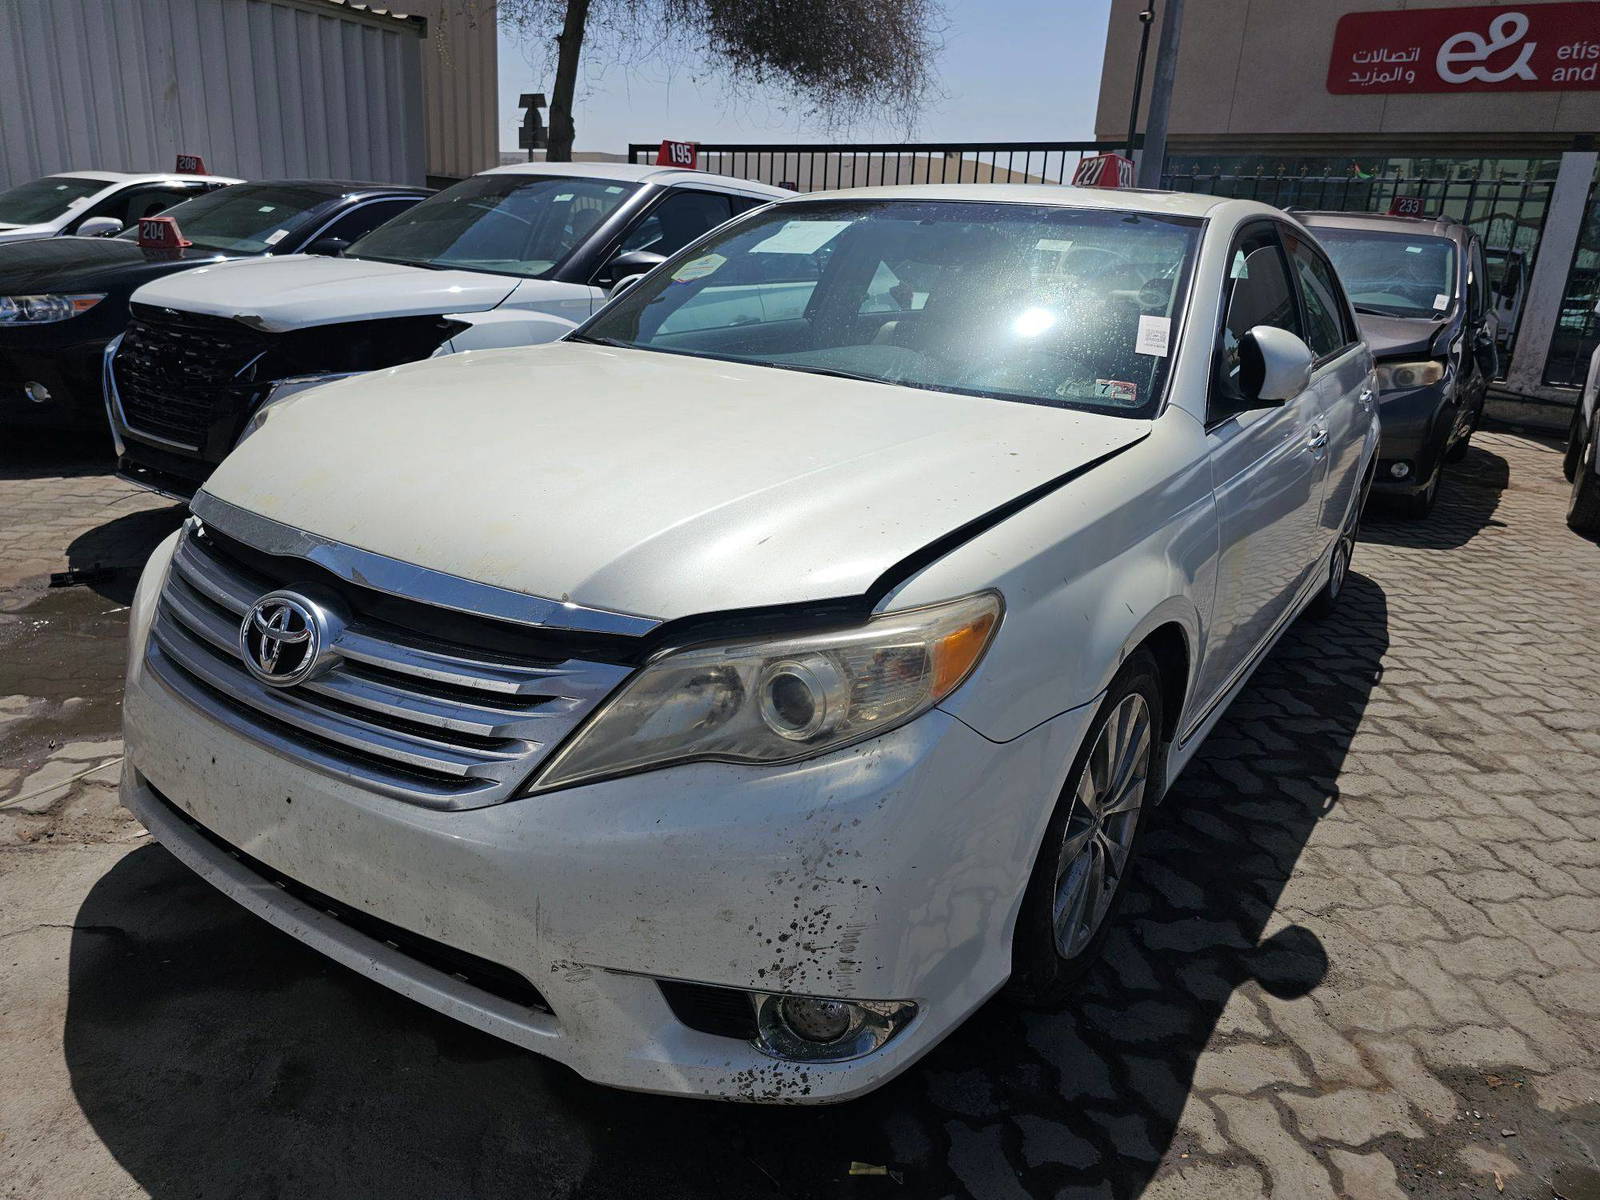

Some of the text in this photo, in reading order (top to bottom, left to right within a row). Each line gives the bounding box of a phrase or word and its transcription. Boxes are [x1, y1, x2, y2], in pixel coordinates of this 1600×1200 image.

[1353, 47, 1420, 63] اتصالات
[1551, 63, 1598, 81] and
[670, 143, 692, 164] 195
[1075, 157, 1106, 186] 227
[1399, 199, 1419, 213] 233
[143, 222, 165, 240] 204
